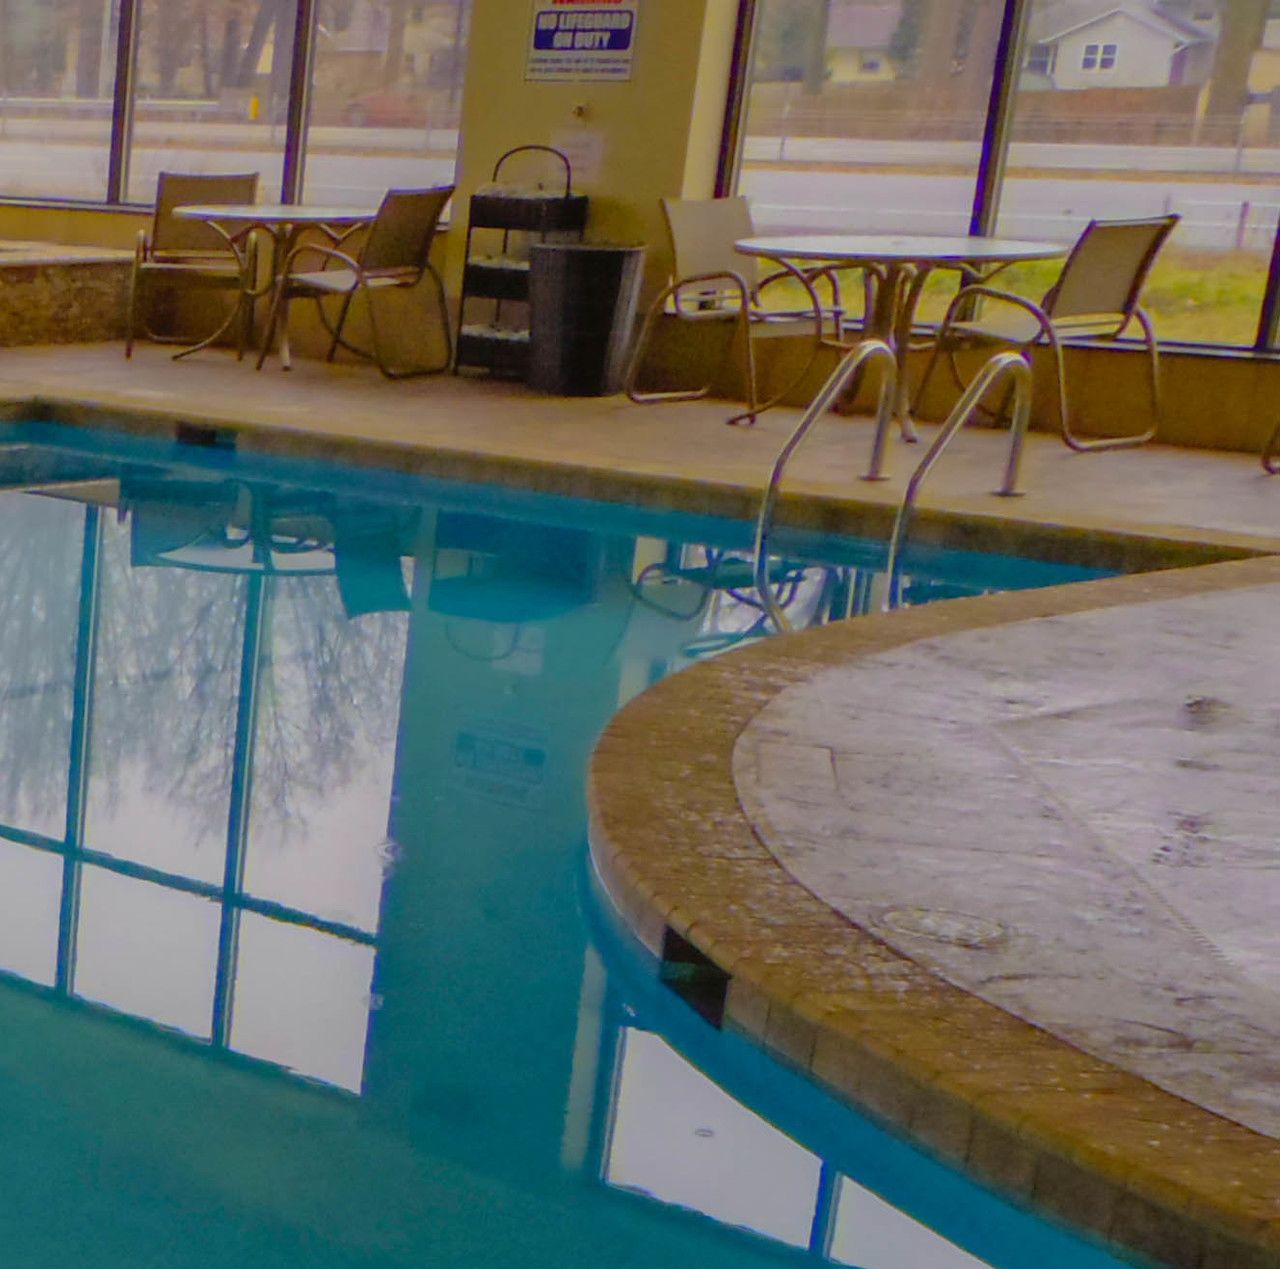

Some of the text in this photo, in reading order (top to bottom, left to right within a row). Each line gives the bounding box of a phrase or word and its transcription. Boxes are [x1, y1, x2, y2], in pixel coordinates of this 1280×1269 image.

[539, 13, 630, 30] NO LIFEGUARD
[553, 31, 611, 48] ON DUTY
